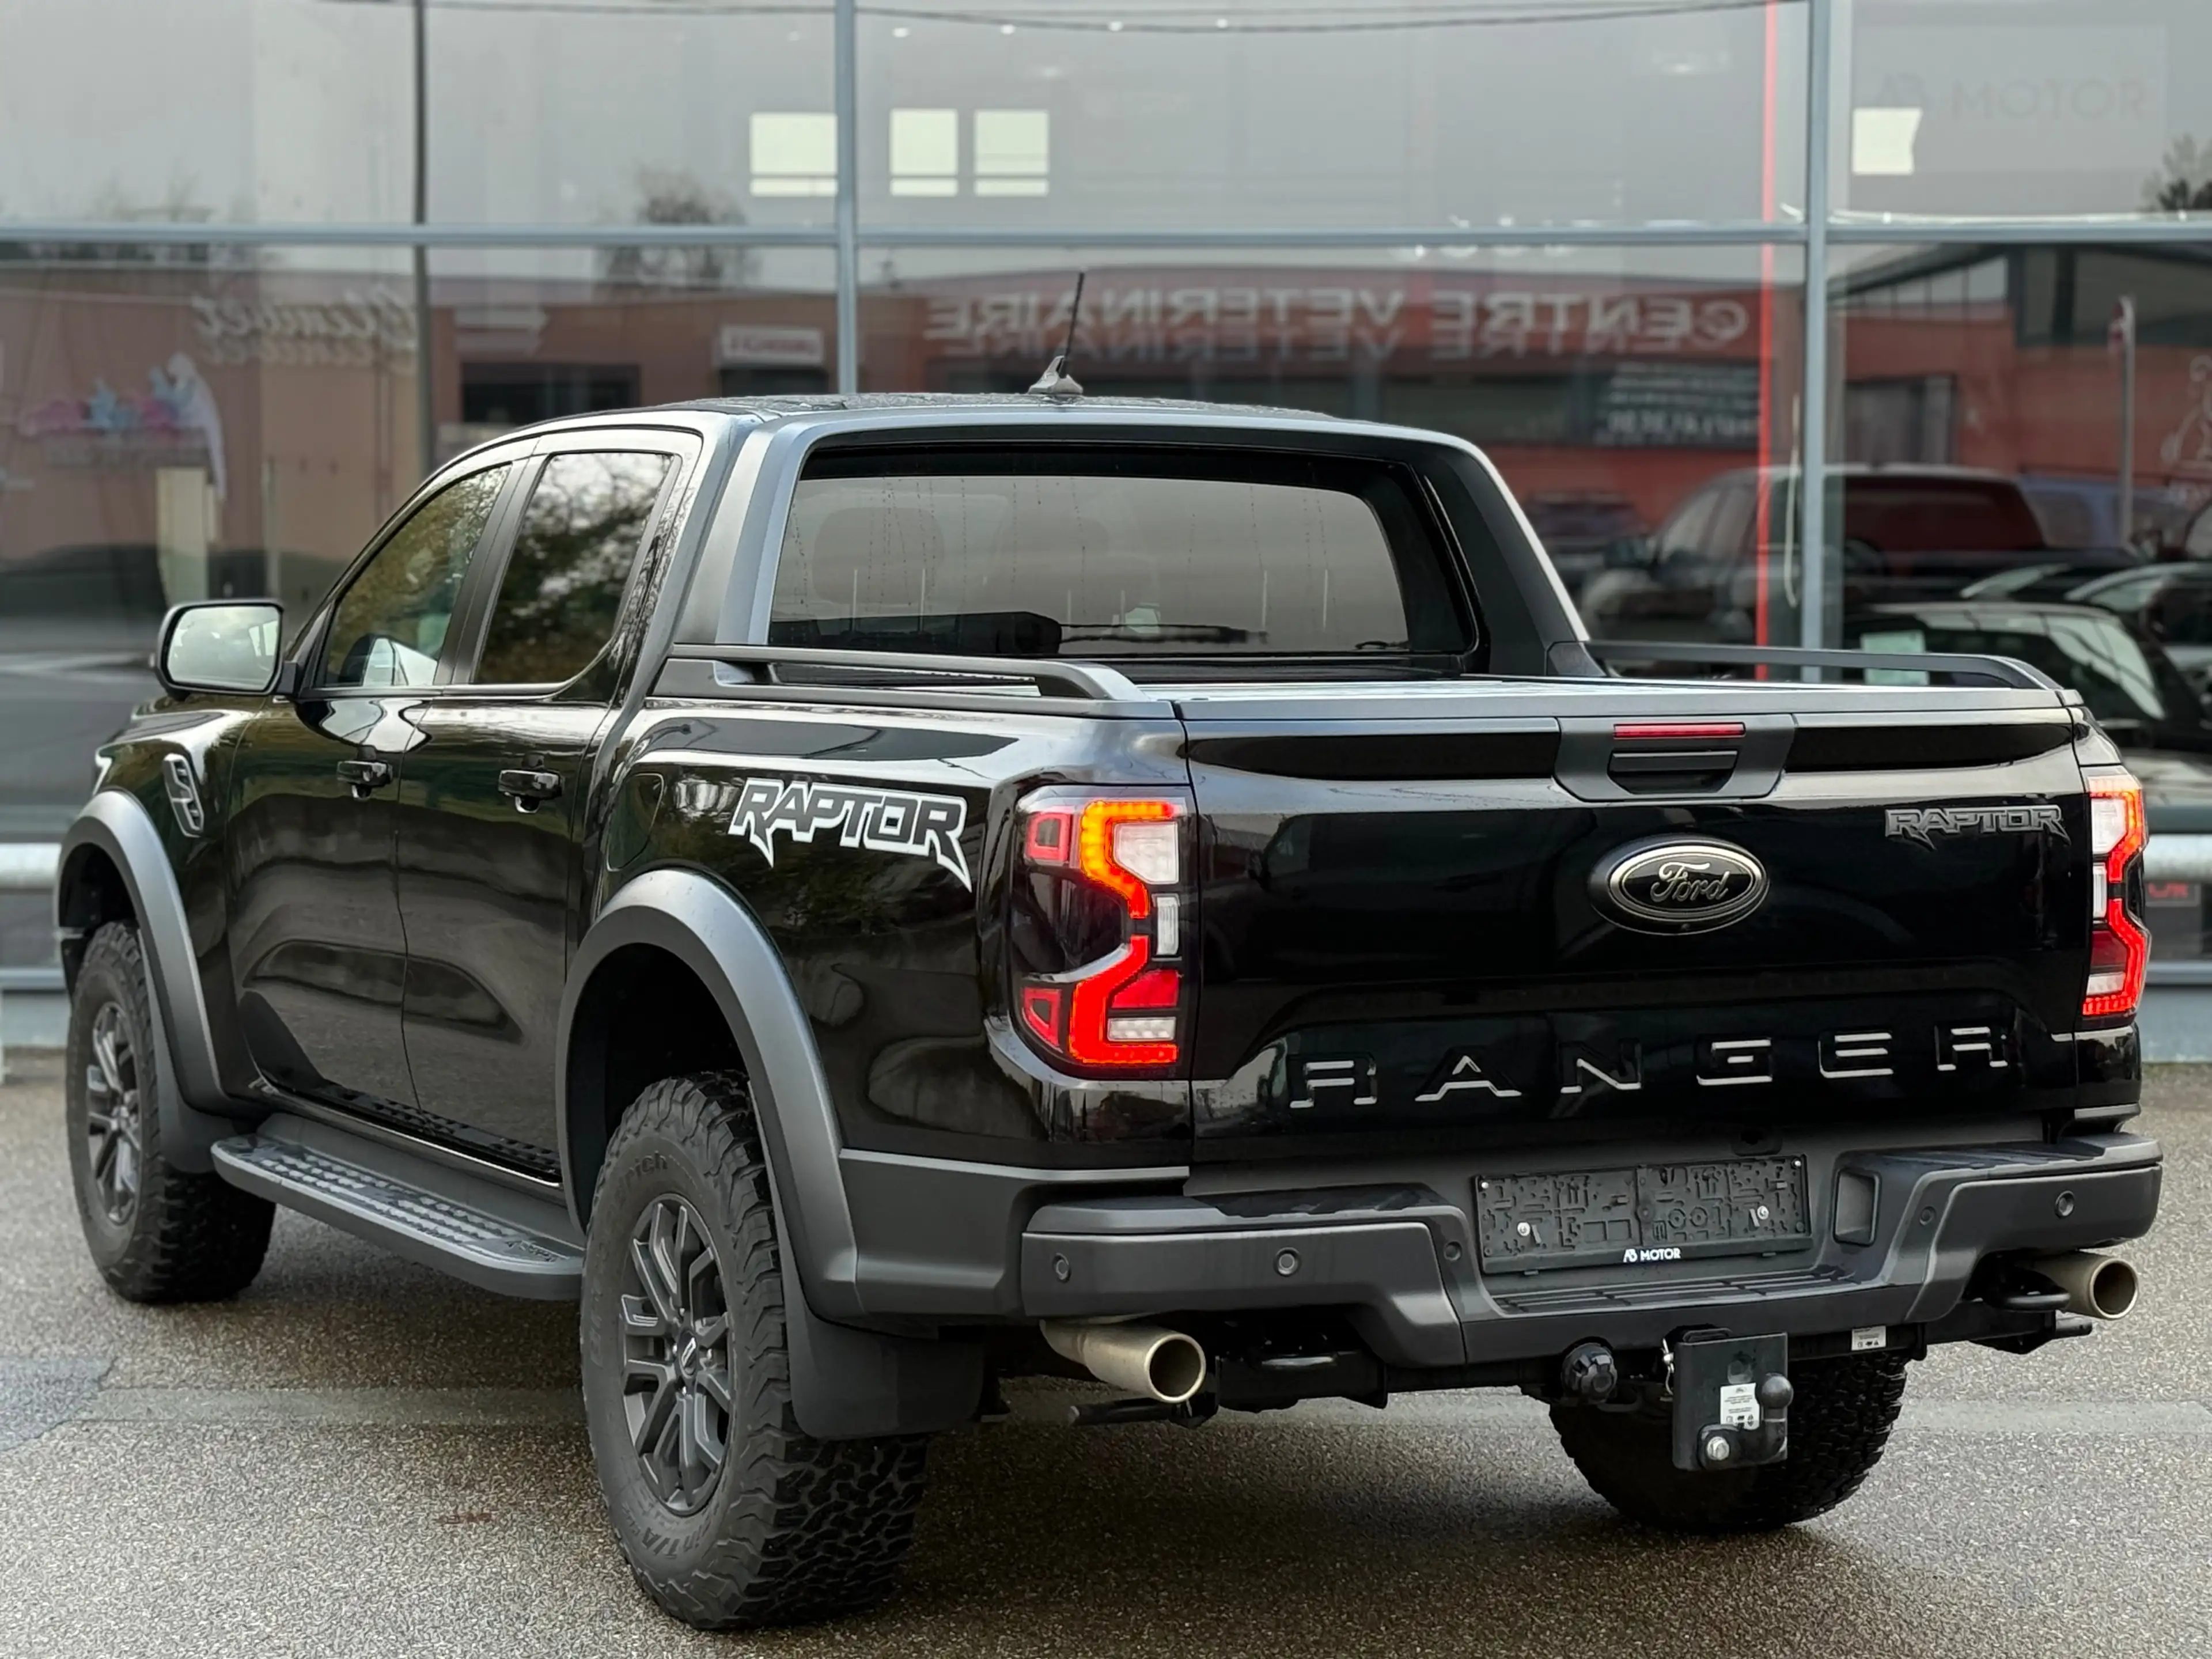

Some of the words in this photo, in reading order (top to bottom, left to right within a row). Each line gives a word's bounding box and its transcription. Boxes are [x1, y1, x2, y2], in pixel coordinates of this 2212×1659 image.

[1951, 78, 2145, 121] MOTOR
[728, 777, 972, 893] RAPTOR
[1885, 805, 2071, 850] RAPTOR
[1650, 862, 1730, 903] Ford
[1288, 1022, 2010, 1109] RANGER
[1640, 1247, 1681, 1262] MOTOR
